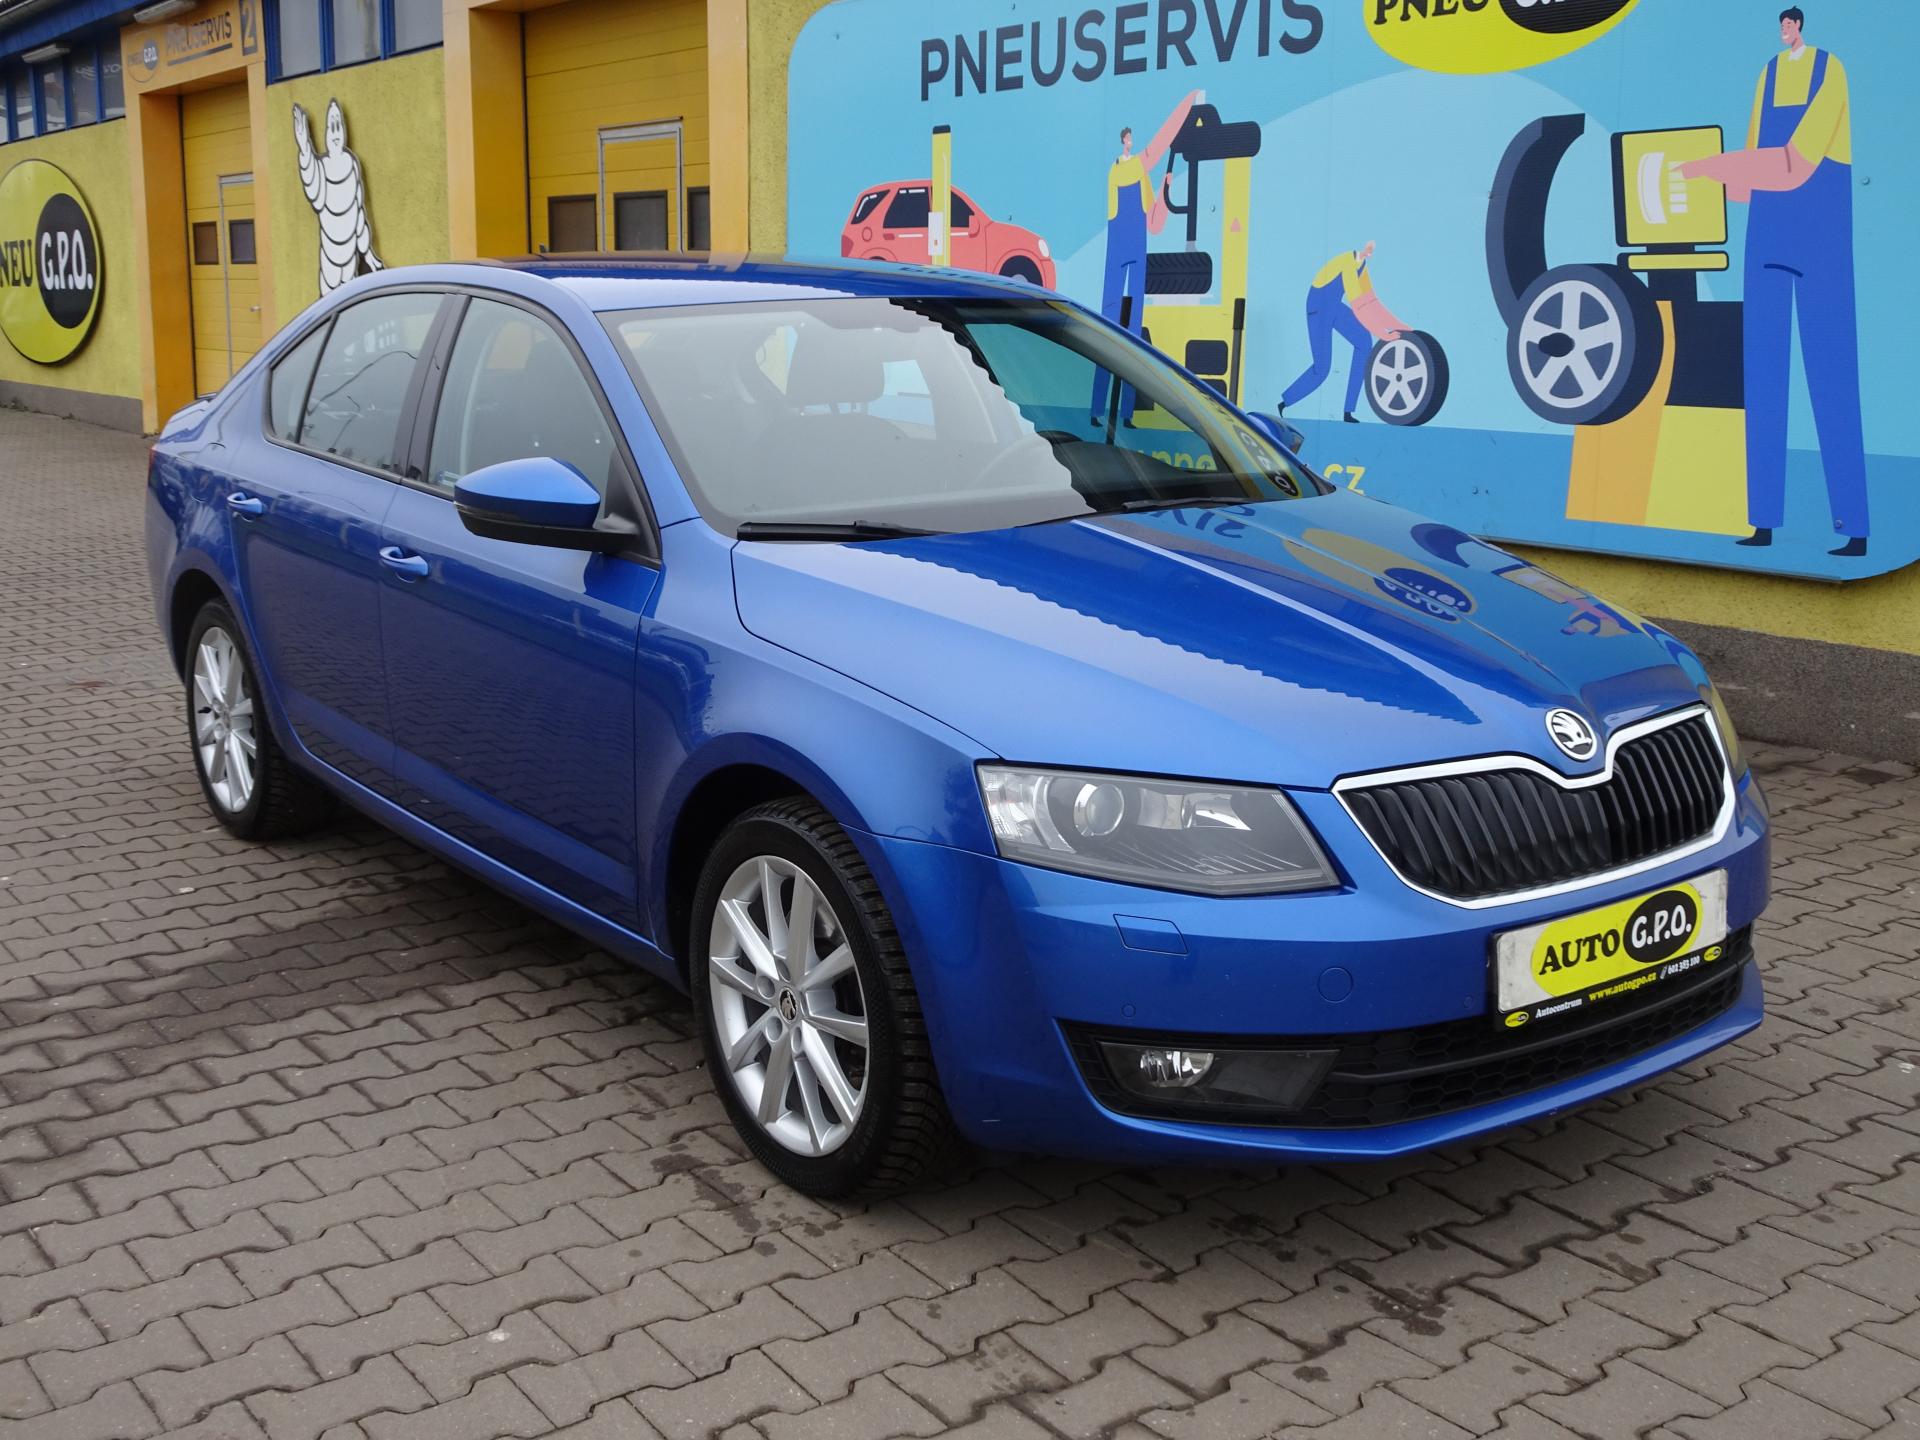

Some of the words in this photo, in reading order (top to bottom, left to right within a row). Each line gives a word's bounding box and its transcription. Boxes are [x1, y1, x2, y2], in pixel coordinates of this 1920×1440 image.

[921, 0, 1323, 101] PNEUSERVIS
[41, 229, 94, 290] G.P.O.
[1539, 929, 1620, 975] AUTO
[1632, 905, 1692, 948] G.P.O.
[1535, 998, 1583, 1019] Autocentrum
[1588, 972, 1657, 1002] www.autogpo.cz
